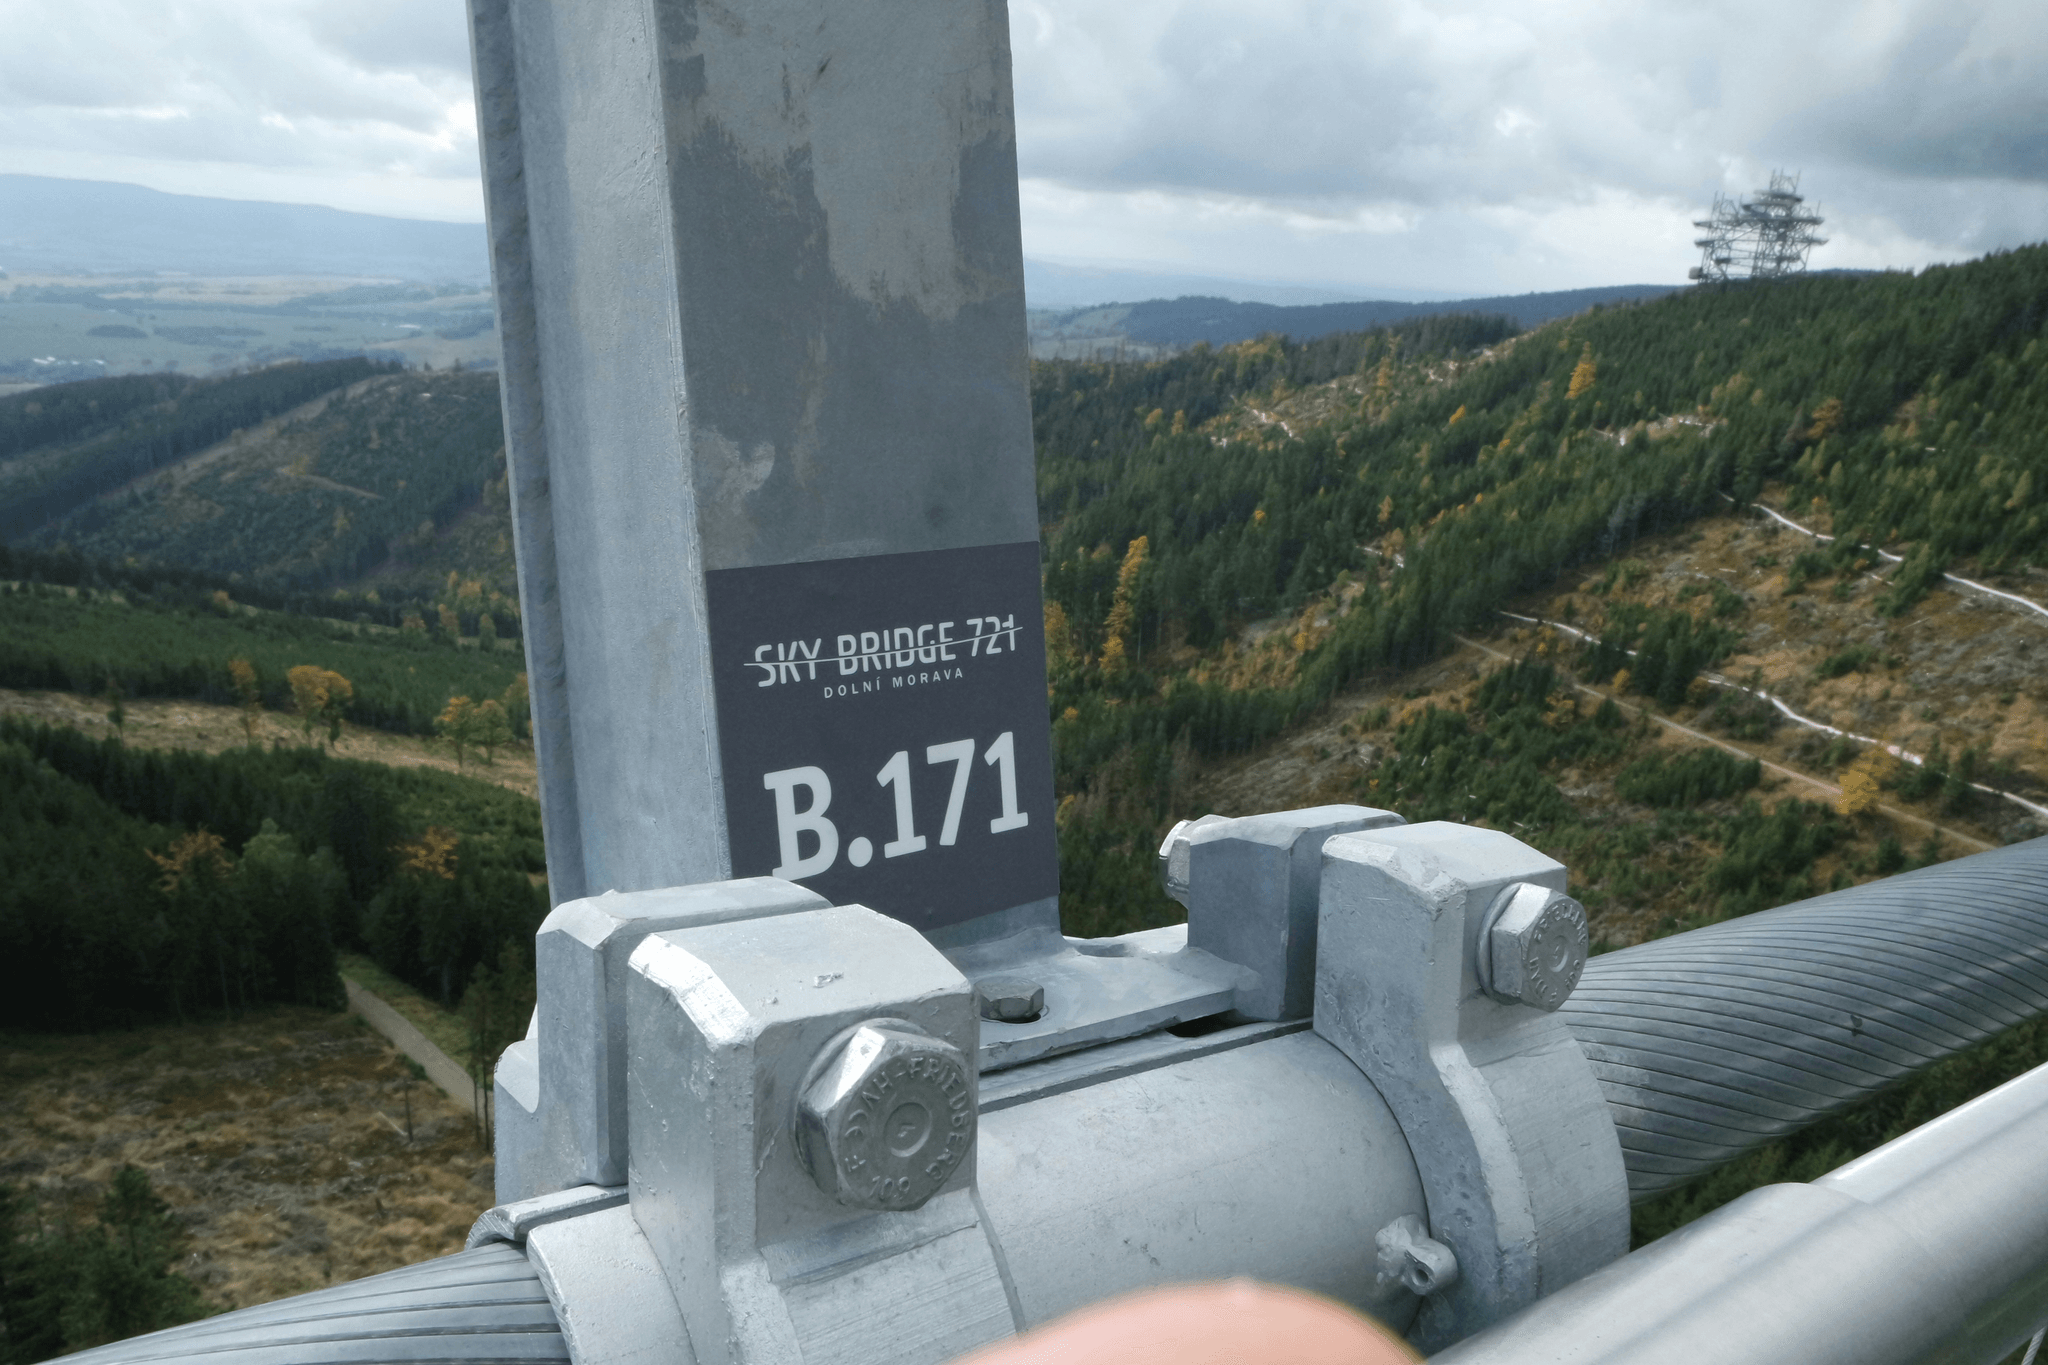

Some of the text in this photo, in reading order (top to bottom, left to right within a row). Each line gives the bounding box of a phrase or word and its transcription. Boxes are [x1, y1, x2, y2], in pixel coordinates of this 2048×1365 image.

[754, 613, 1016, 688] SKY BRIDGE 721
[823, 667, 964, 699] DOLNÍ MORAVA
[763, 731, 1029, 882] B.171
